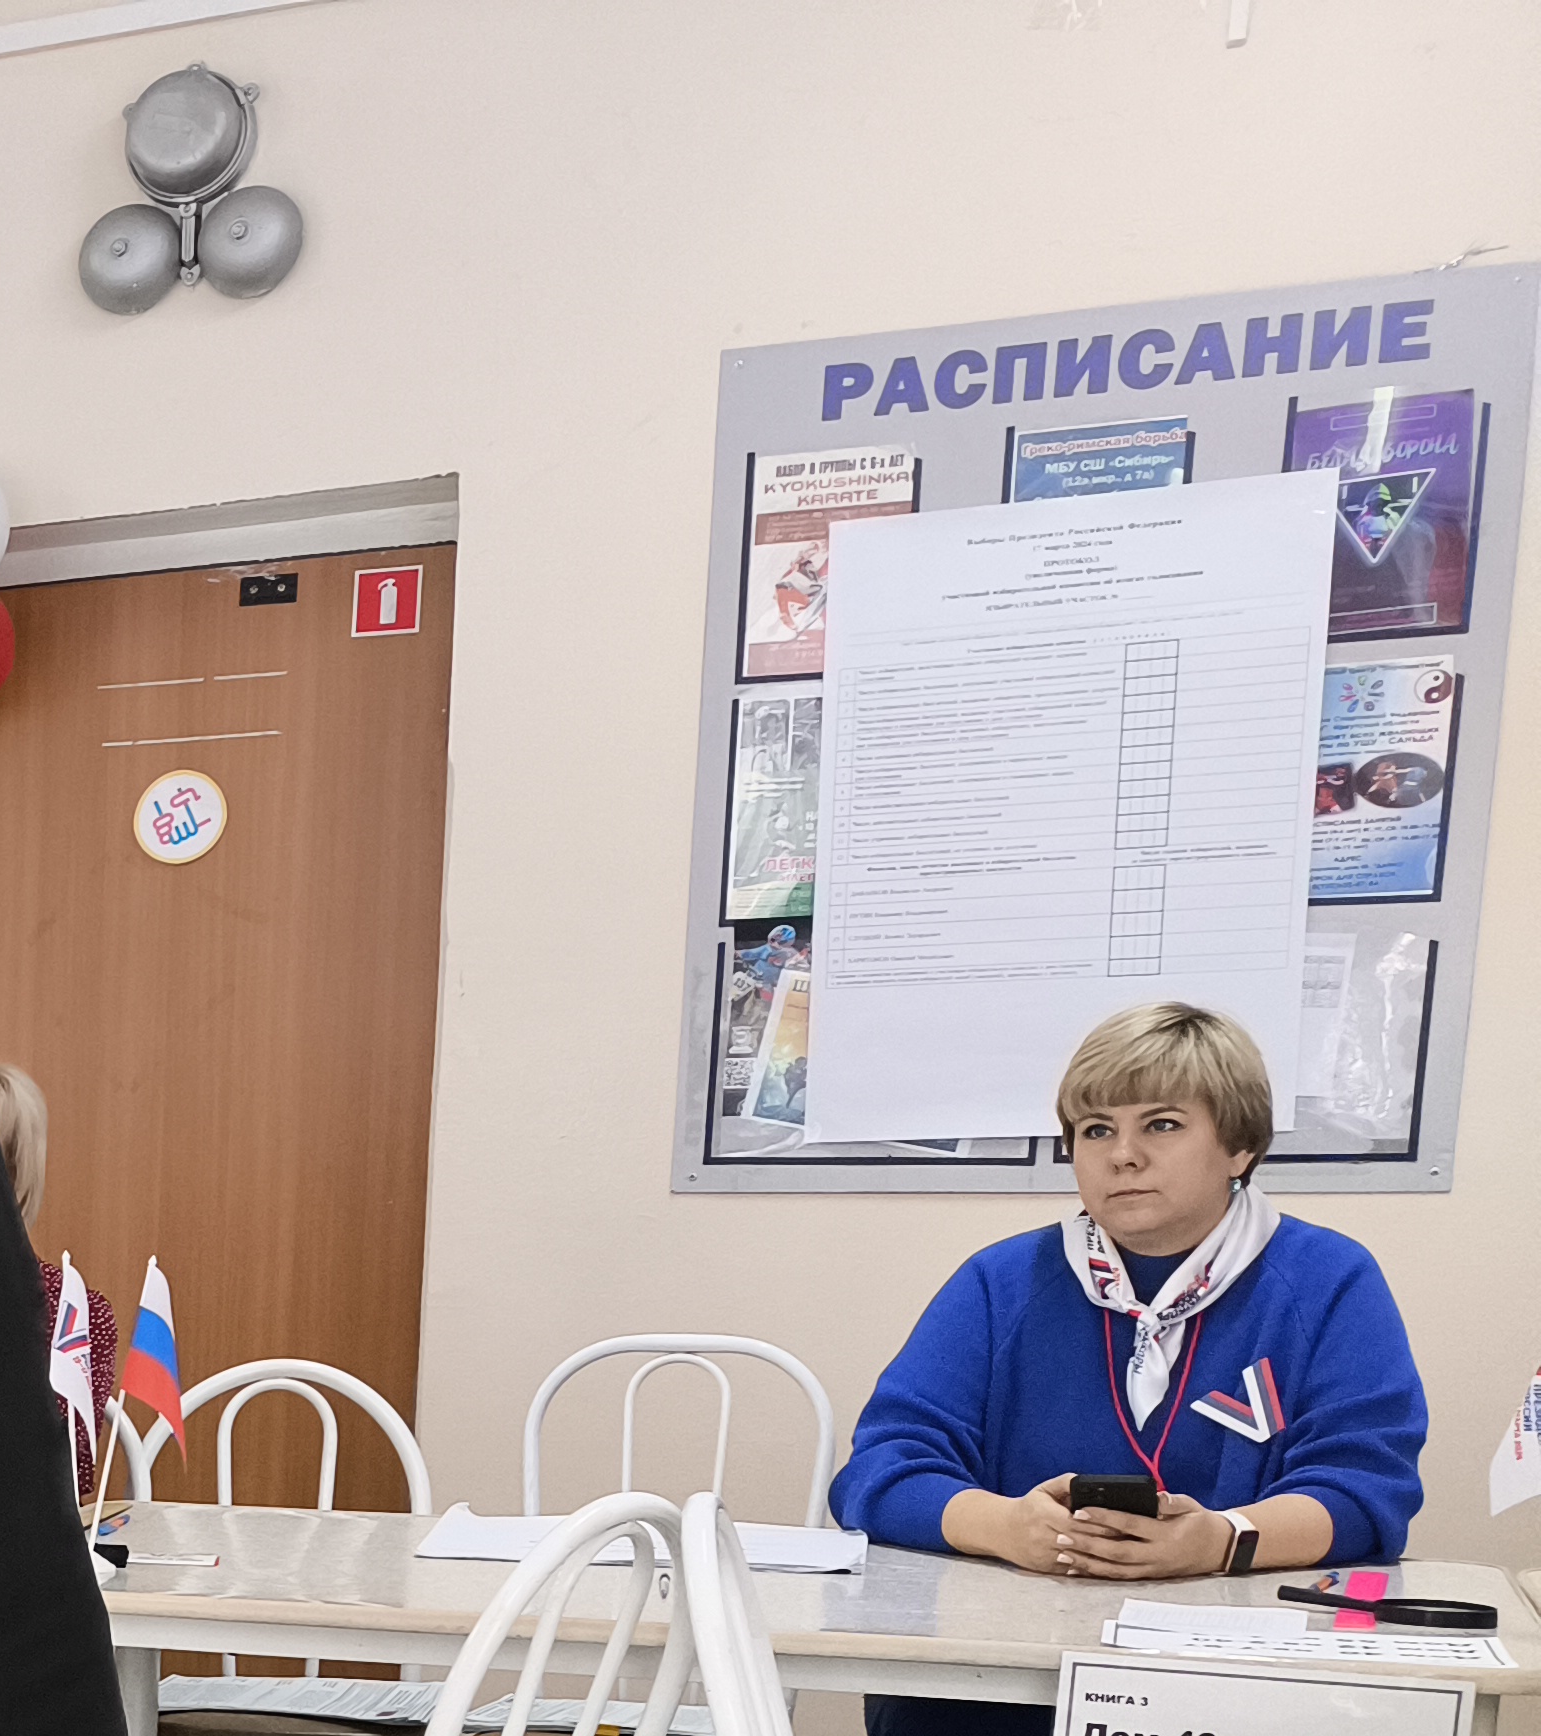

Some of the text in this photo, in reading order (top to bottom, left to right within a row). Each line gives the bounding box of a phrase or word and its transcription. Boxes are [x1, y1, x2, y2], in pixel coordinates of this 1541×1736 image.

[821, 298, 1436, 421] РАСПИСАНИЕ
[1022, 436, 1131, 457] Греко-римская
[819, 459, 856, 474] ГРУППЫ
[1045, 462, 1077, 474] МБУ
[1080, 458, 1105, 470] СШ
[764, 471, 910, 495] KYOKUSHINKA
[797, 489, 879, 508] KARATE
[766, 858, 814, 871] ЛЕГК
[1085, 1692, 1149, 1707] КНИГА 3
